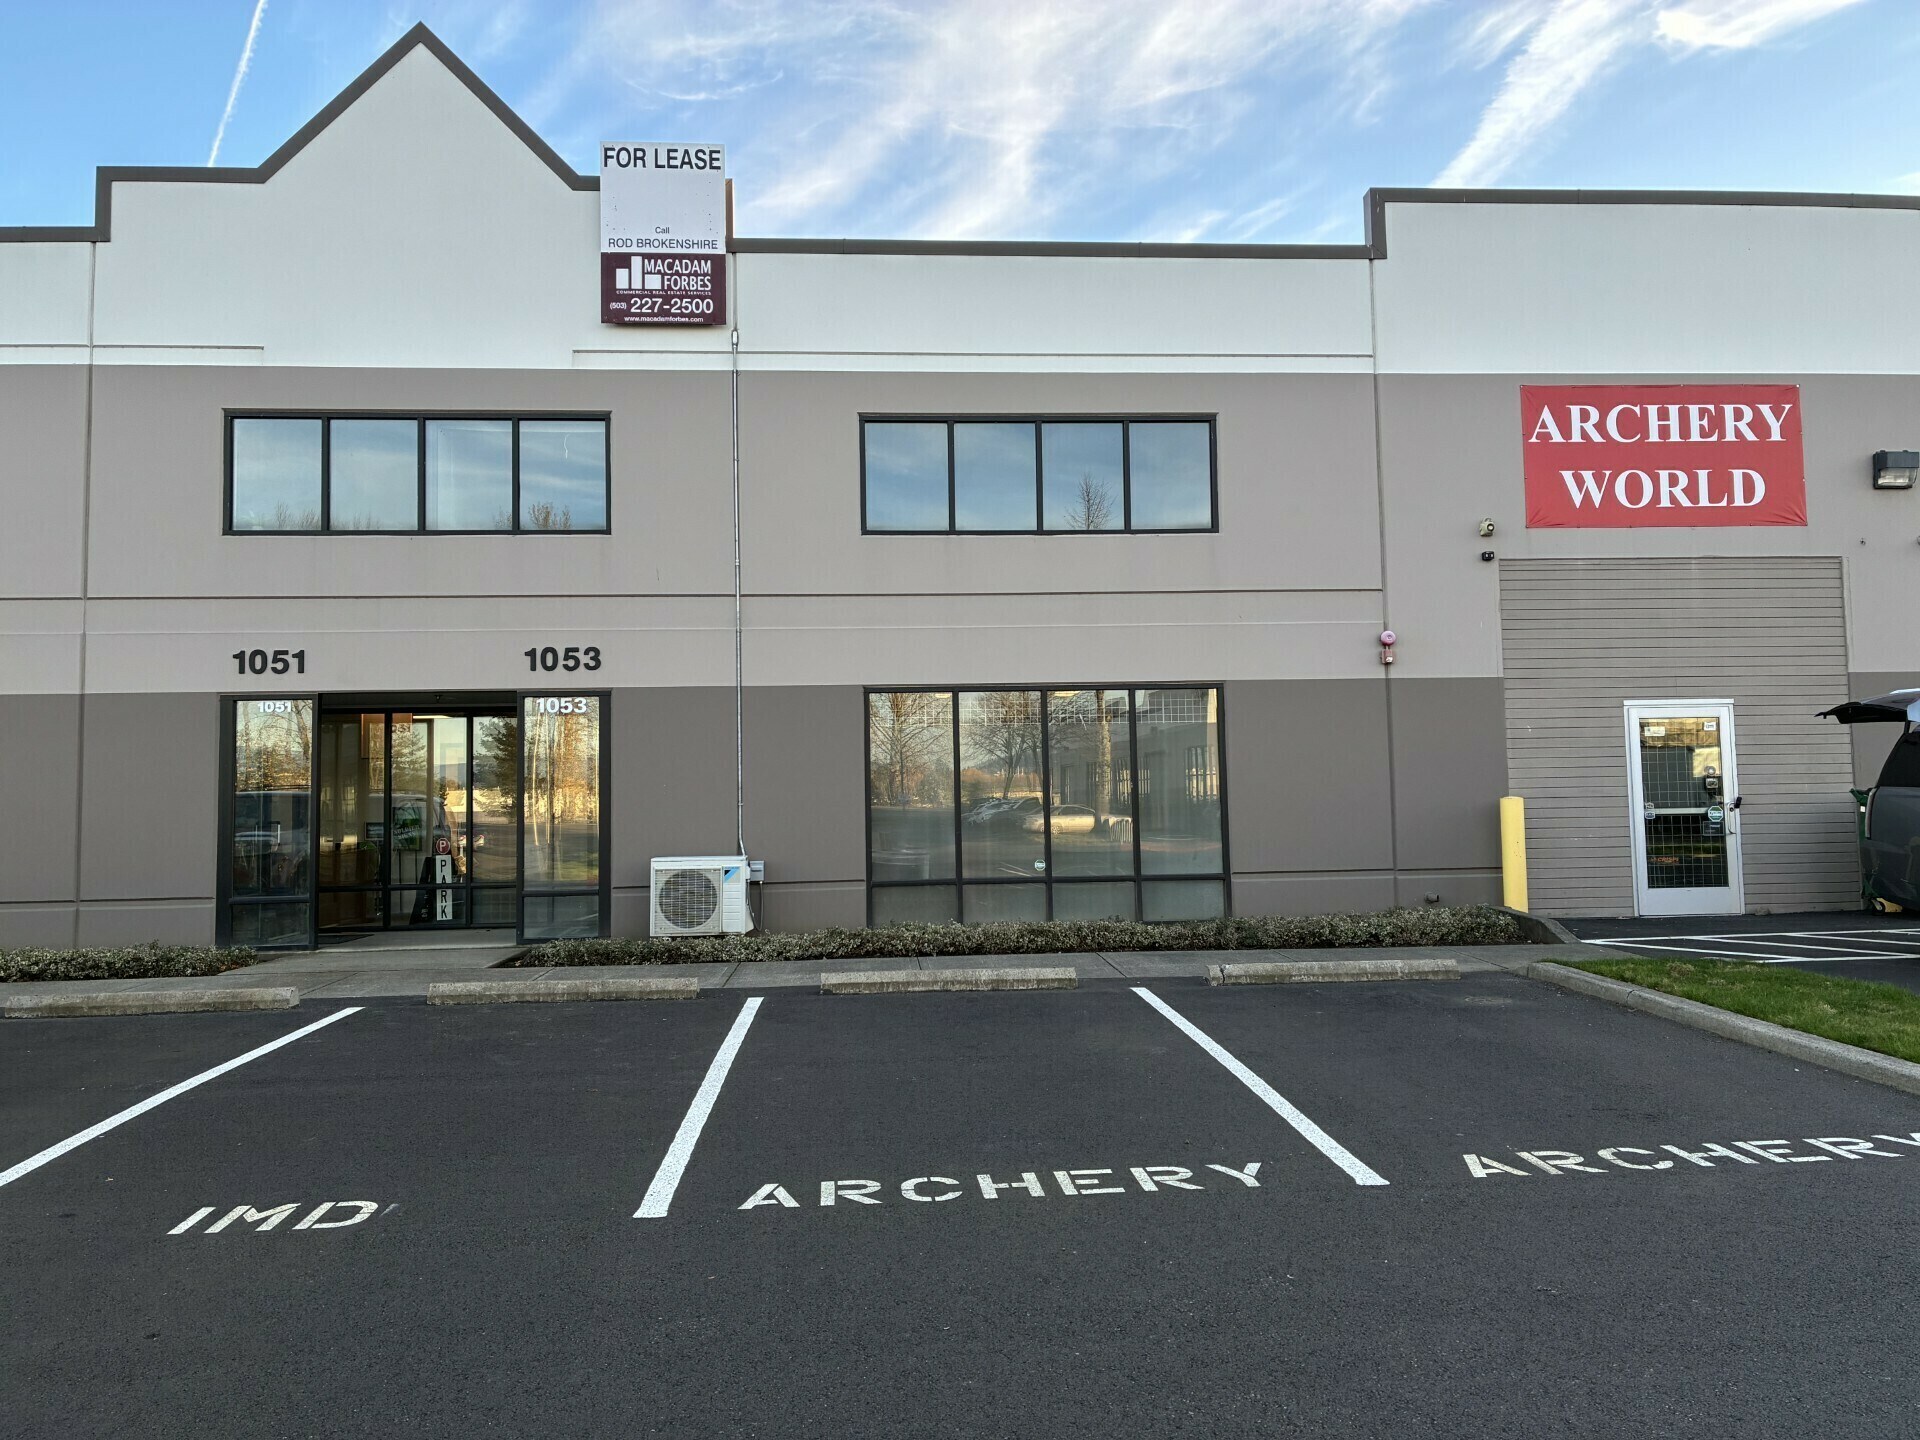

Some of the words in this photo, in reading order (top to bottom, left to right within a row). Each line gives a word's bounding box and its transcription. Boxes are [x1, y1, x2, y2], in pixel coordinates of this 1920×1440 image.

[603, 147, 646, 168] FOR
[654, 148, 721, 170] LEASE
[608, 238, 633, 248] ROD
[636, 238, 718, 249] BROKENSHIRE
[644, 259, 711, 274] MACADAM
[664, 275, 711, 290] FORBES
[609, 302, 627, 310] (503)
[630, 297, 714, 314] 227-2500
[624, 315, 704, 323] www.macadamforbes.com
[1528, 404, 1793, 443] ARCHERY
[1559, 469, 1766, 509] WORLD
[232, 649, 305, 675] 1051
[524, 646, 601, 672] 1053
[257, 701, 292, 713] 1051
[537, 697, 587, 714] 1053
[440, 859, 448, 919] PARK
[737, 1162, 1262, 1210] ARCHERY
[166, 1200, 379, 1235] IMD
